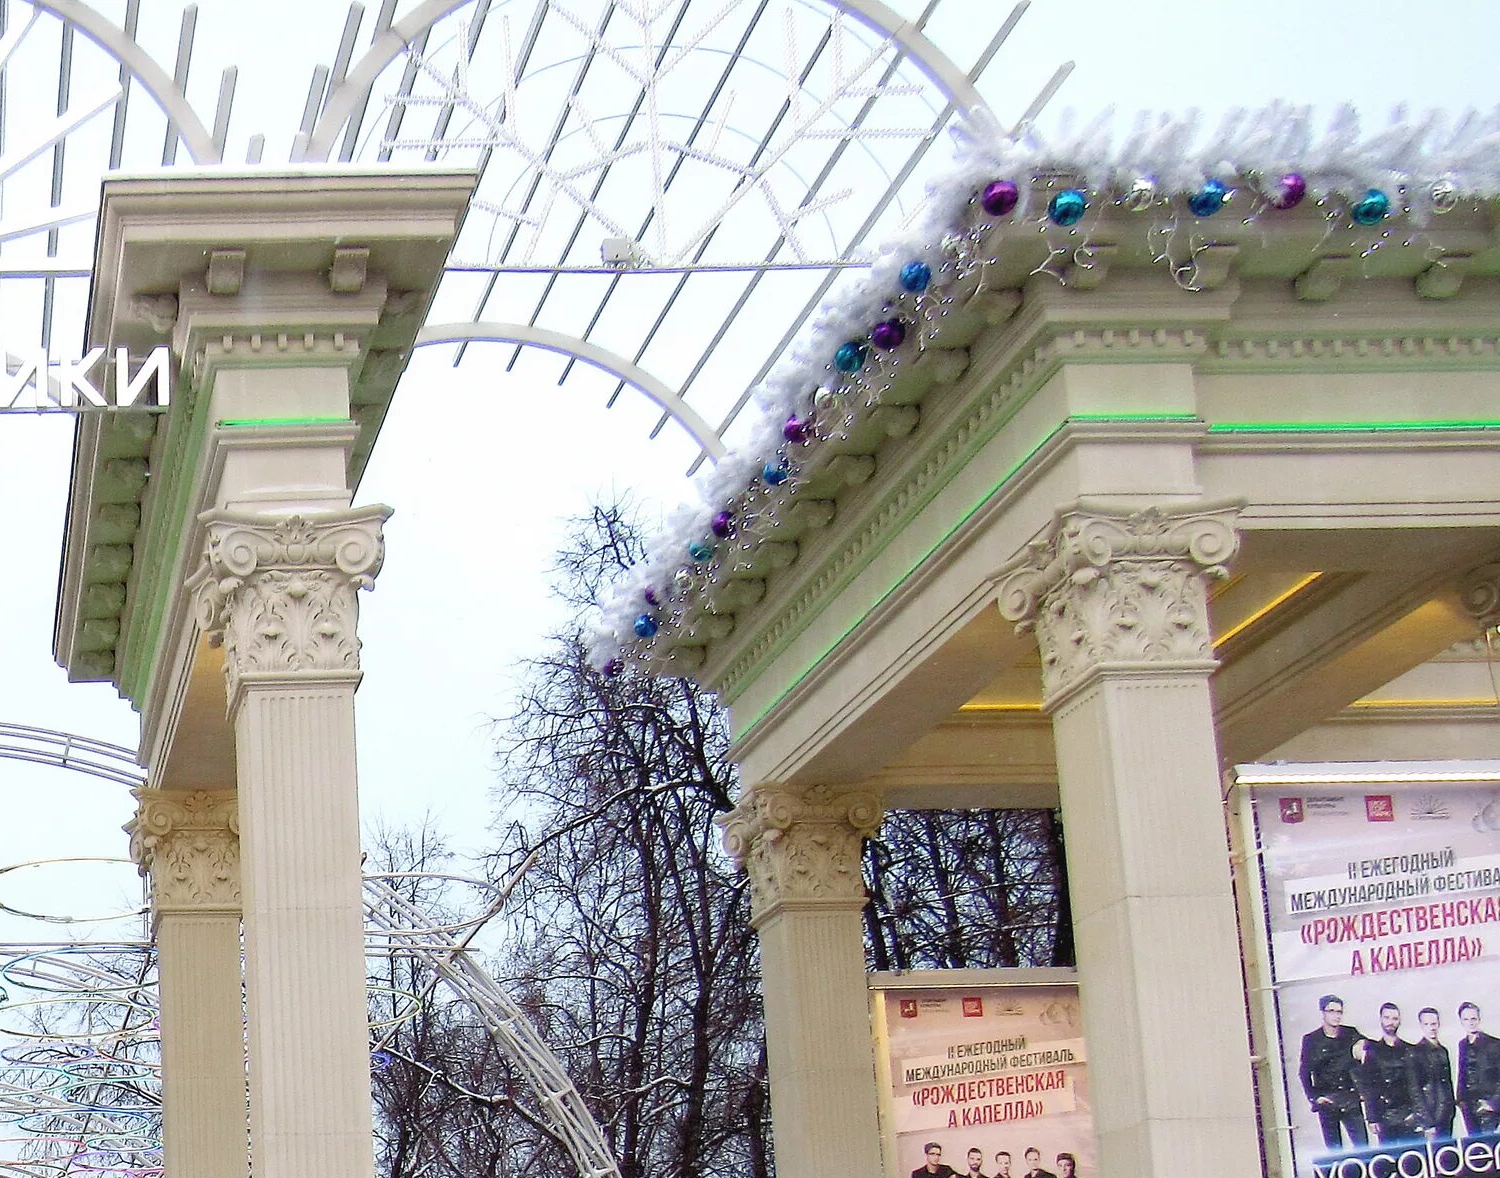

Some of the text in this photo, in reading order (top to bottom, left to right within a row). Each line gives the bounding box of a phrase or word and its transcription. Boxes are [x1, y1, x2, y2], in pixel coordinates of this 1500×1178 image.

[1361, 847, 1454, 878] ЕЖЕГОДНЫЙ
[1290, 874, 1430, 912] МЕЖДУНАРОДНЫЙ
[1301, 897, 1500, 945] «РОЖДЕСТВЕНСКА
[1351, 935, 1483, 976] А КАПЕЛЛА»
[957, 1035, 1026, 1058] ЕЖЕГОДНЫЙ
[905, 1048, 1074, 1082] МЕЖДУНАРОДНЫЙ ФЕСТИВАЛЬ
[912, 1070, 1065, 1107] «РОЖДЕСТВЕНСКАЯ
[948, 1101, 1043, 1128] А КАПЕЛЛА»
